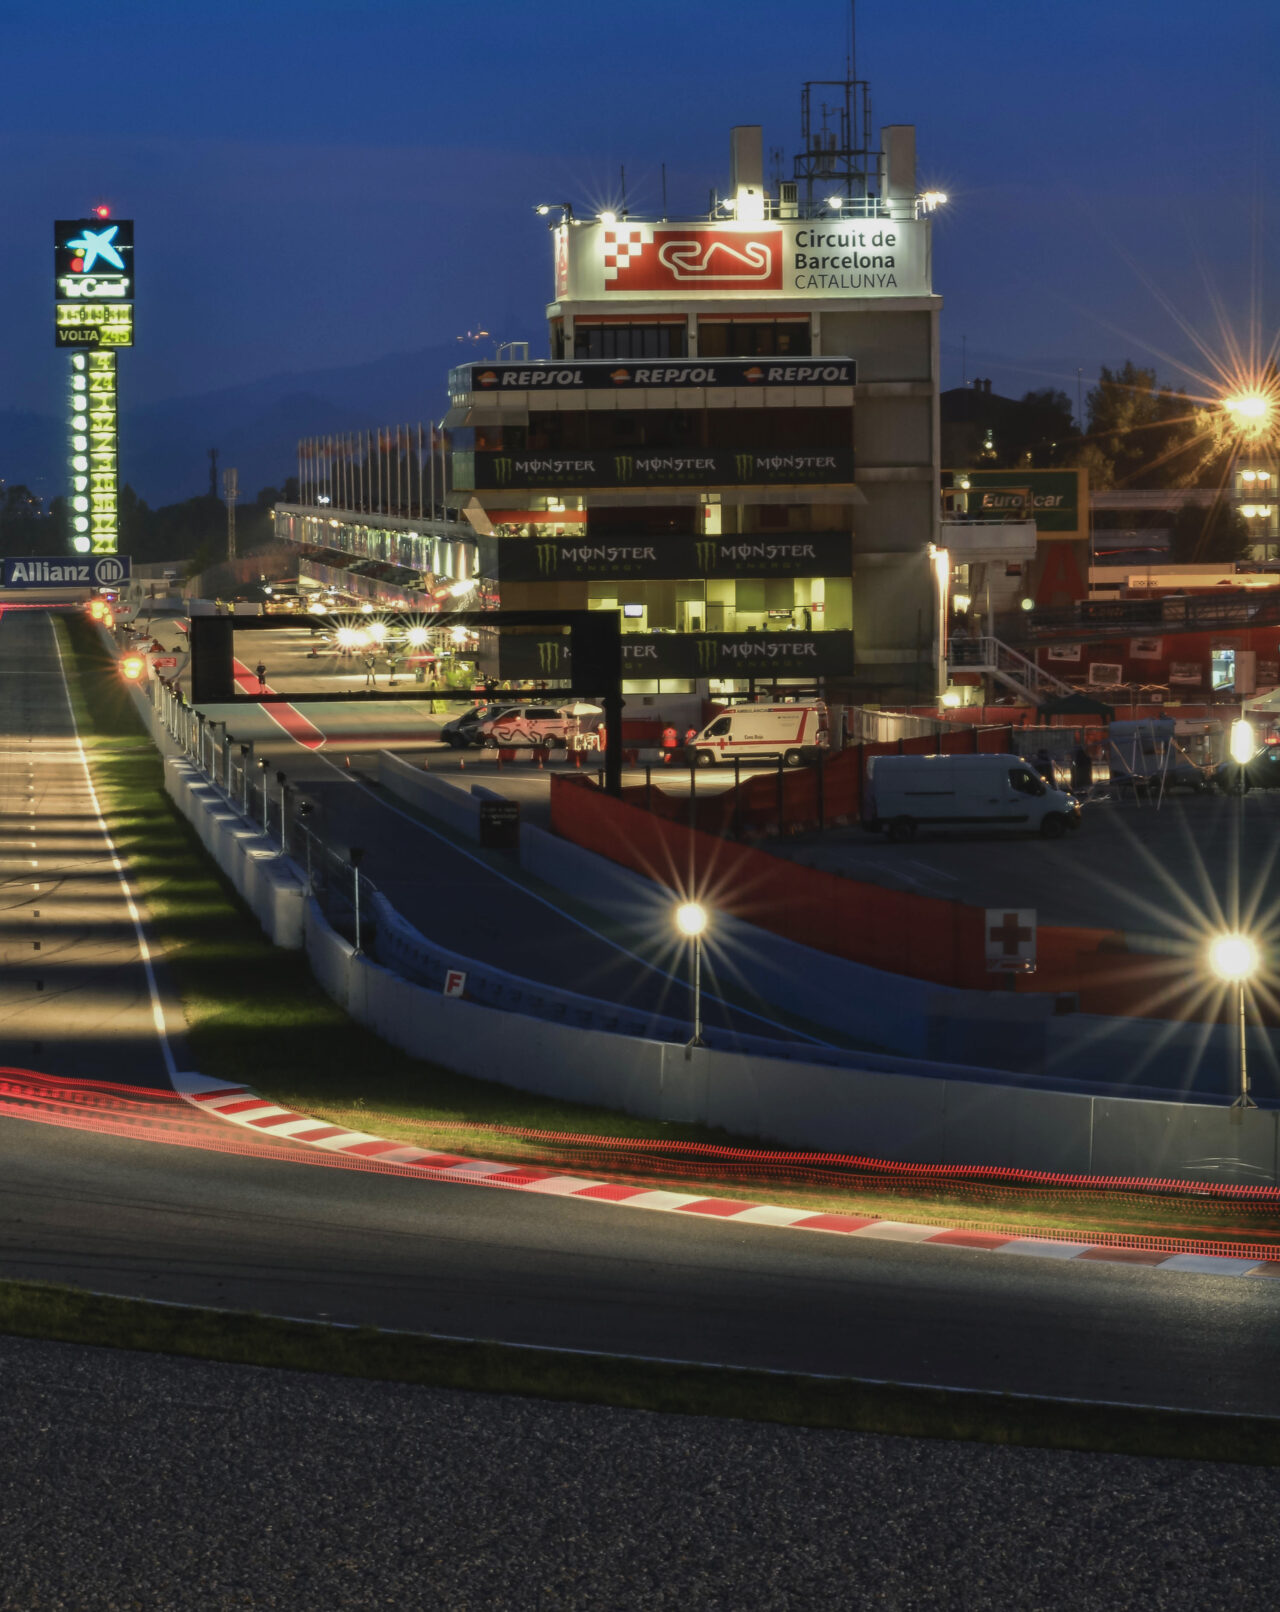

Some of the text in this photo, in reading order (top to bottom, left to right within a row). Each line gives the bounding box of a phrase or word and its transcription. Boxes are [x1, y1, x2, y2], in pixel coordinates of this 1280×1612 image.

[795, 229, 896, 248] Circuit de
[795, 252, 895, 269] Barcelona
[794, 274, 897, 289] CATALUNYA
[59, 330, 99, 341] VOLTA
[502, 370, 584, 386] REPSOL
[634, 368, 717, 384] REPSOL
[767, 366, 850, 382] REPSOL
[515, 458, 596, 474] MONSTER
[635, 456, 716, 472] MONSTER
[756, 455, 837, 470] MONSTER
[562, 545, 657, 563] MONSTER
[720, 542, 816, 560] MONSTER
[11, 562, 90, 582] Allianz
[721, 641, 817, 658] MONSTER
[446, 973, 463, 993] F
